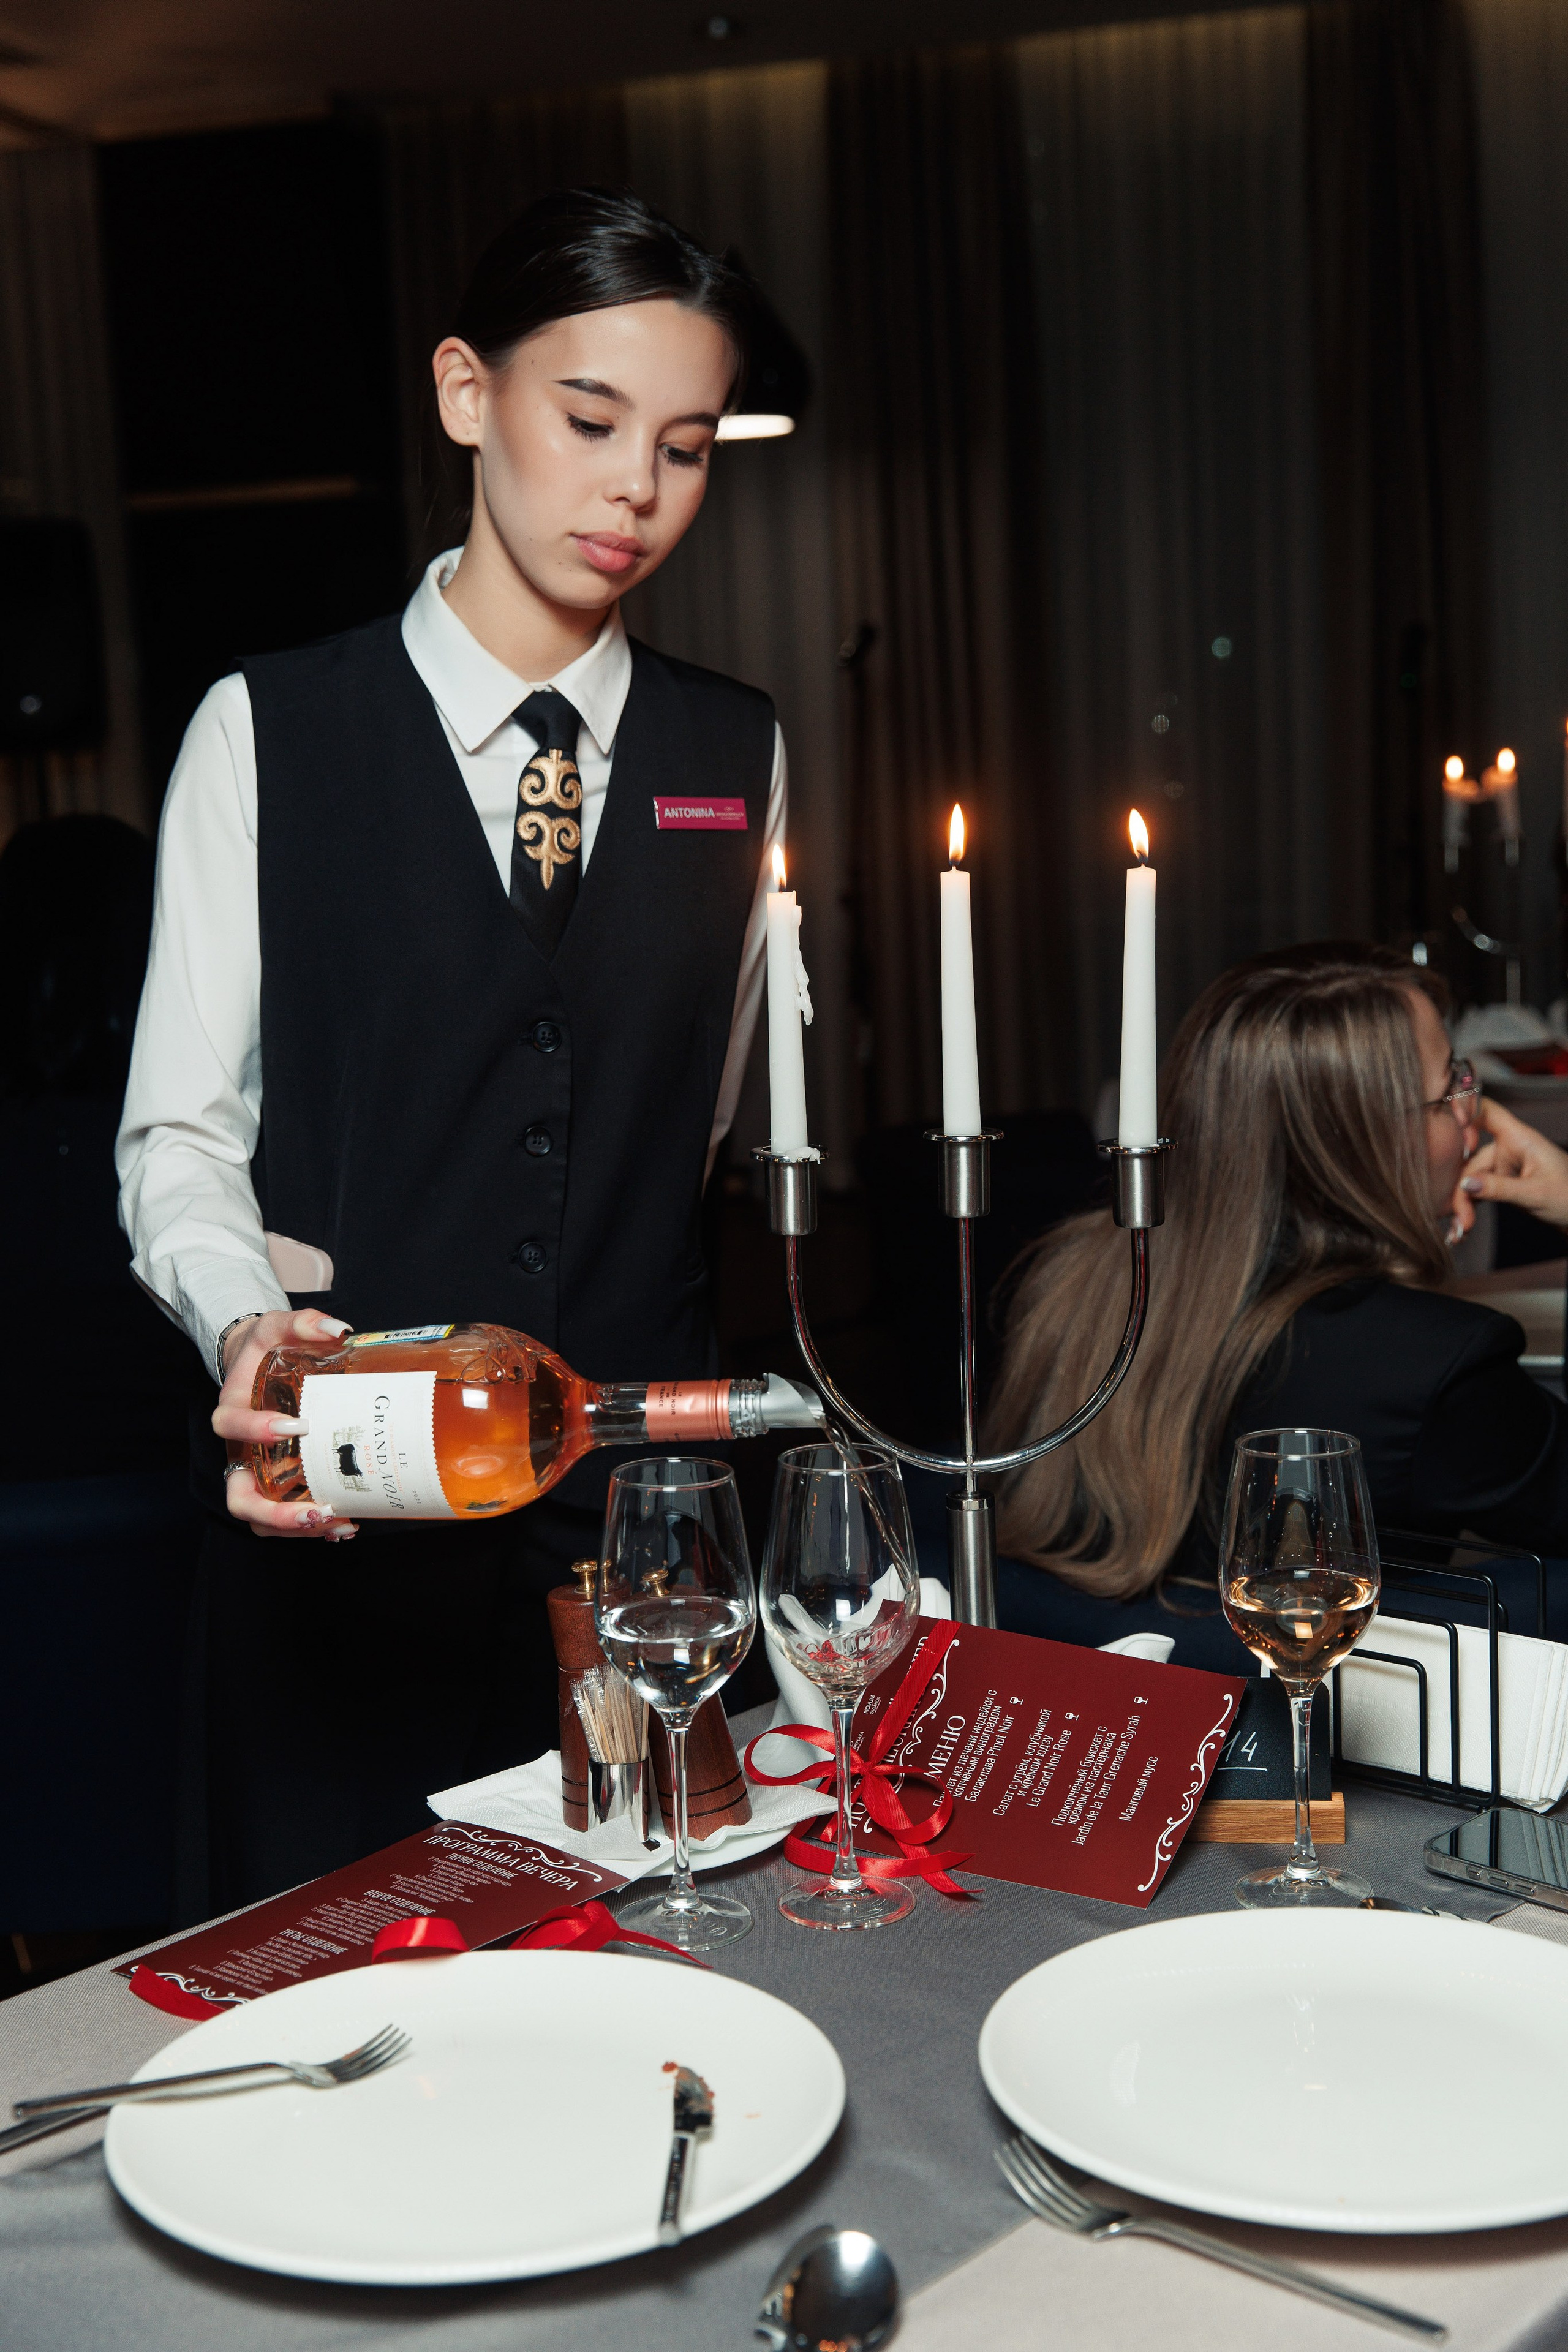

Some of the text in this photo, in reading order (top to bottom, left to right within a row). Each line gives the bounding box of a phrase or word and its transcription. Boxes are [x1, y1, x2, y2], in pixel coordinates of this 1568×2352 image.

[664, 807, 715, 818] ANTONINA
[364, 1446, 377, 1475] ROSÉ
[374, 1395, 405, 1509] GRAND NOIR
[398, 1453, 408, 1468] LE
[412, 1490, 421, 1504] 2021
[864, 1695, 875, 1714] NOVUM
[974, 1706, 1002, 1755] виноградом
[924, 1716, 965, 1778] МЕНЮ
[952, 1766, 963, 1777] из
[958, 1735, 978, 1765] печени
[972, 1697, 994, 1733] индейки
[965, 1715, 1014, 1801] Балаклава Pinot Noir
[993, 1790, 1014, 1815] Салат
[1012, 1758, 1032, 1784] угрём,
[1025, 1709, 1051, 1755] клубникой
[1021, 1758, 1042, 1789] кремом
[1036, 1735, 1054, 1757] юдзу
[1027, 1730, 1071, 1806] Le Grand Noir Rose
[1051, 1769, 1088, 1825] Подкопчёный
[1080, 1733, 1104, 1768] брискет
[1068, 1733, 1116, 1824] кремом из пастернака
[1072, 1822, 1093, 1845] Jardin
[1085, 1811, 1098, 1820] de
[1094, 1782, 1112, 1798] Taur
[1103, 1741, 1129, 1780] Grenache
[1121, 1716, 1140, 1740] Syrah
[1119, 1757, 1158, 1821] Манговый мусс
[423, 1835, 578, 1889] ПРОГРАММА ВЕЧЕРА
[446, 1853, 518, 1879] ПЕРВОЕ ОТДЕЛЕНИЕ
[364, 1890, 435, 1915] ВТОРОЕ ОТДЕЛЕНИЕ
[279, 1929, 348, 1954] ТРЕТЬЕ ОТДЕЛЕНИЕ
